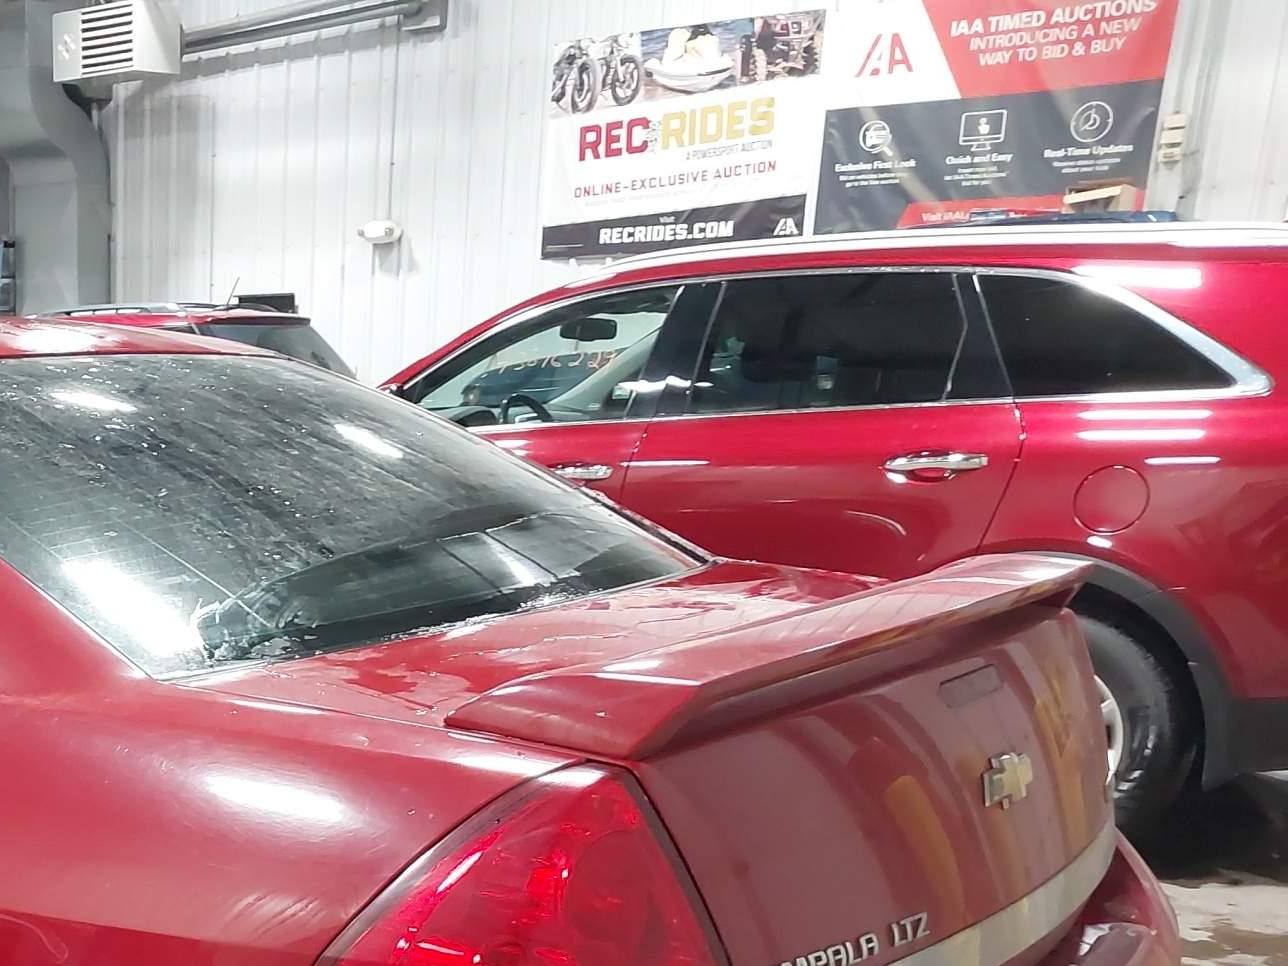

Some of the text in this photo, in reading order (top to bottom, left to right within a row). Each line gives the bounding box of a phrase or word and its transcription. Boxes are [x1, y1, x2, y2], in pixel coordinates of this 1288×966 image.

[951, 0, 1157, 37] IAA TIMED AUCTIONS
[969, 17, 1143, 51] INTRODUCING A NEW
[978, 36, 1127, 67] WAY TO BID & BUY
[578, 116, 651, 161] REC
[662, 96, 776, 149] RIDES
[873, 160, 894, 169] First
[894, 158, 917, 168] Look
[973, 153, 991, 162] and
[992, 152, 1014, 163] Easy
[1092, 144, 1134, 157] Updates
[573, 169, 709, 199] ONLINE-EXCLUSIVE
[713, 159, 777, 179] AUCTION
[598, 220, 735, 245] RECRIDES.COM
[890, 912, 931, 948] LTZ
